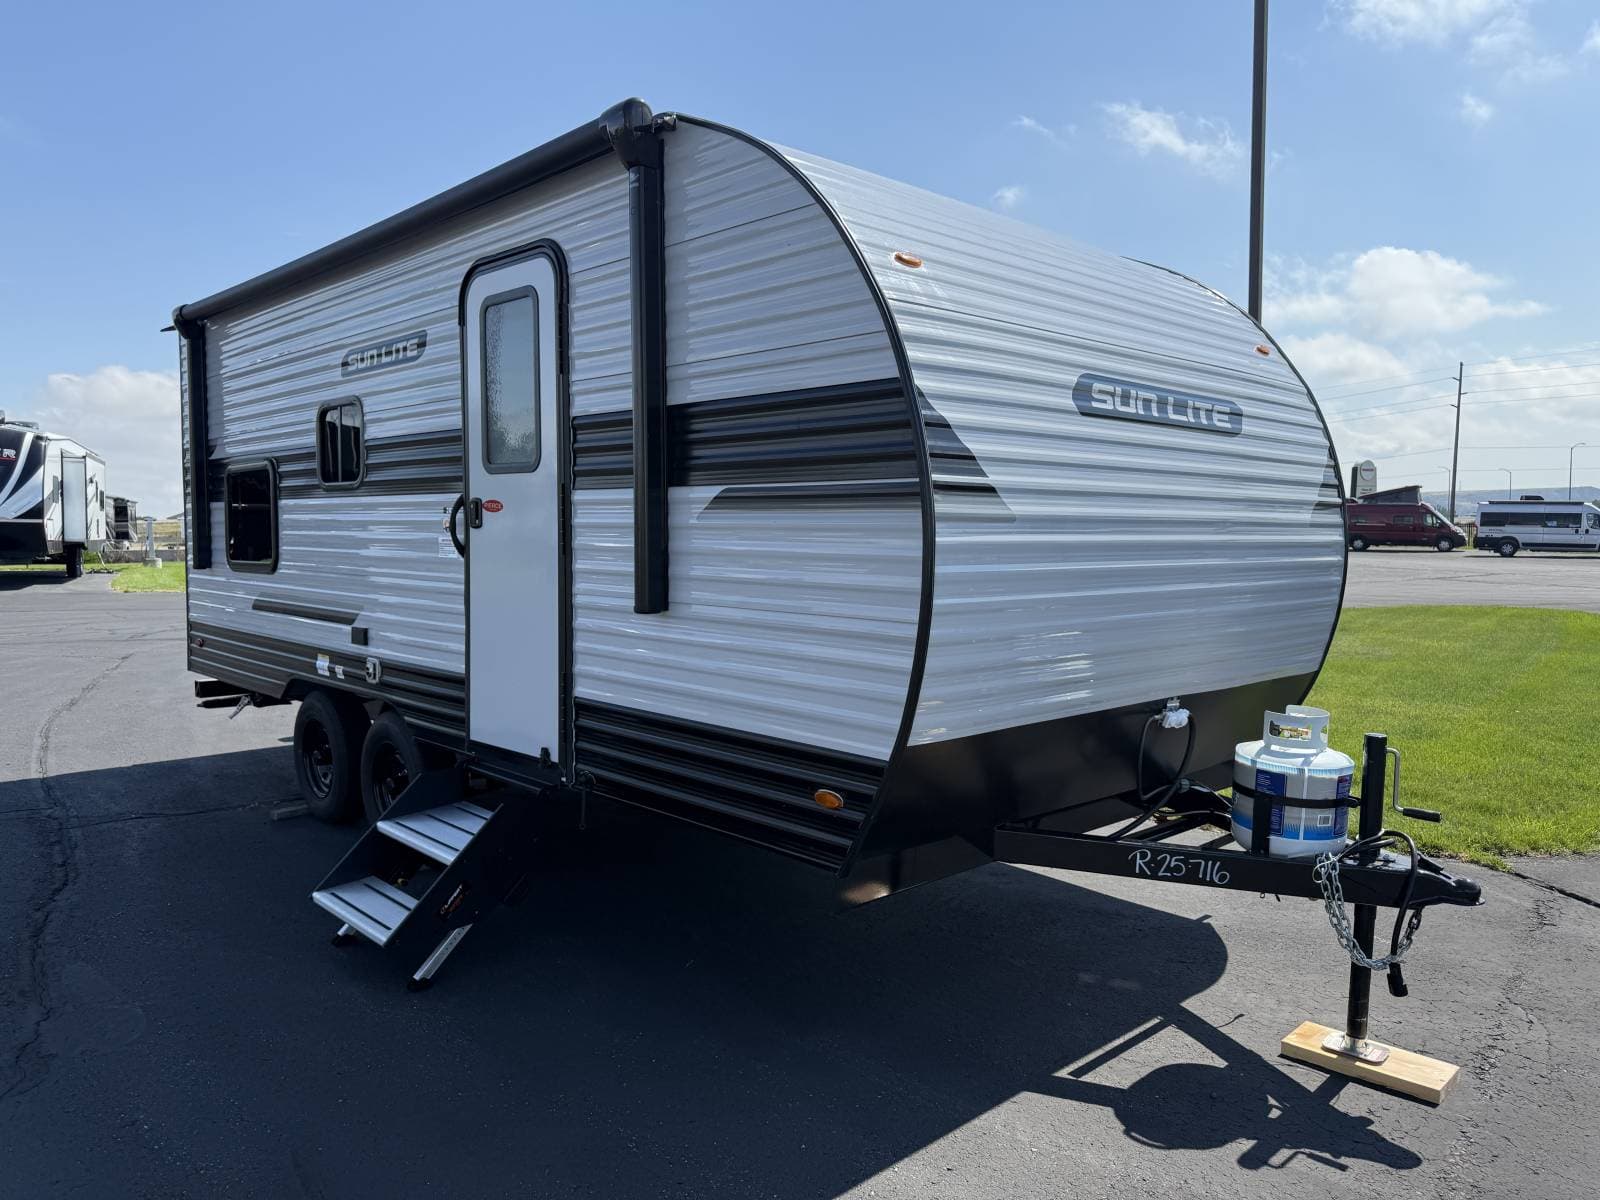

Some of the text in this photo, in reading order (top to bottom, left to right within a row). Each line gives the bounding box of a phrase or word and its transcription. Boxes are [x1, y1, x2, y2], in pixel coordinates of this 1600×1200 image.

[348, 338, 419, 371] SUN LITE
[1091, 382, 1233, 429] SUN LITE
